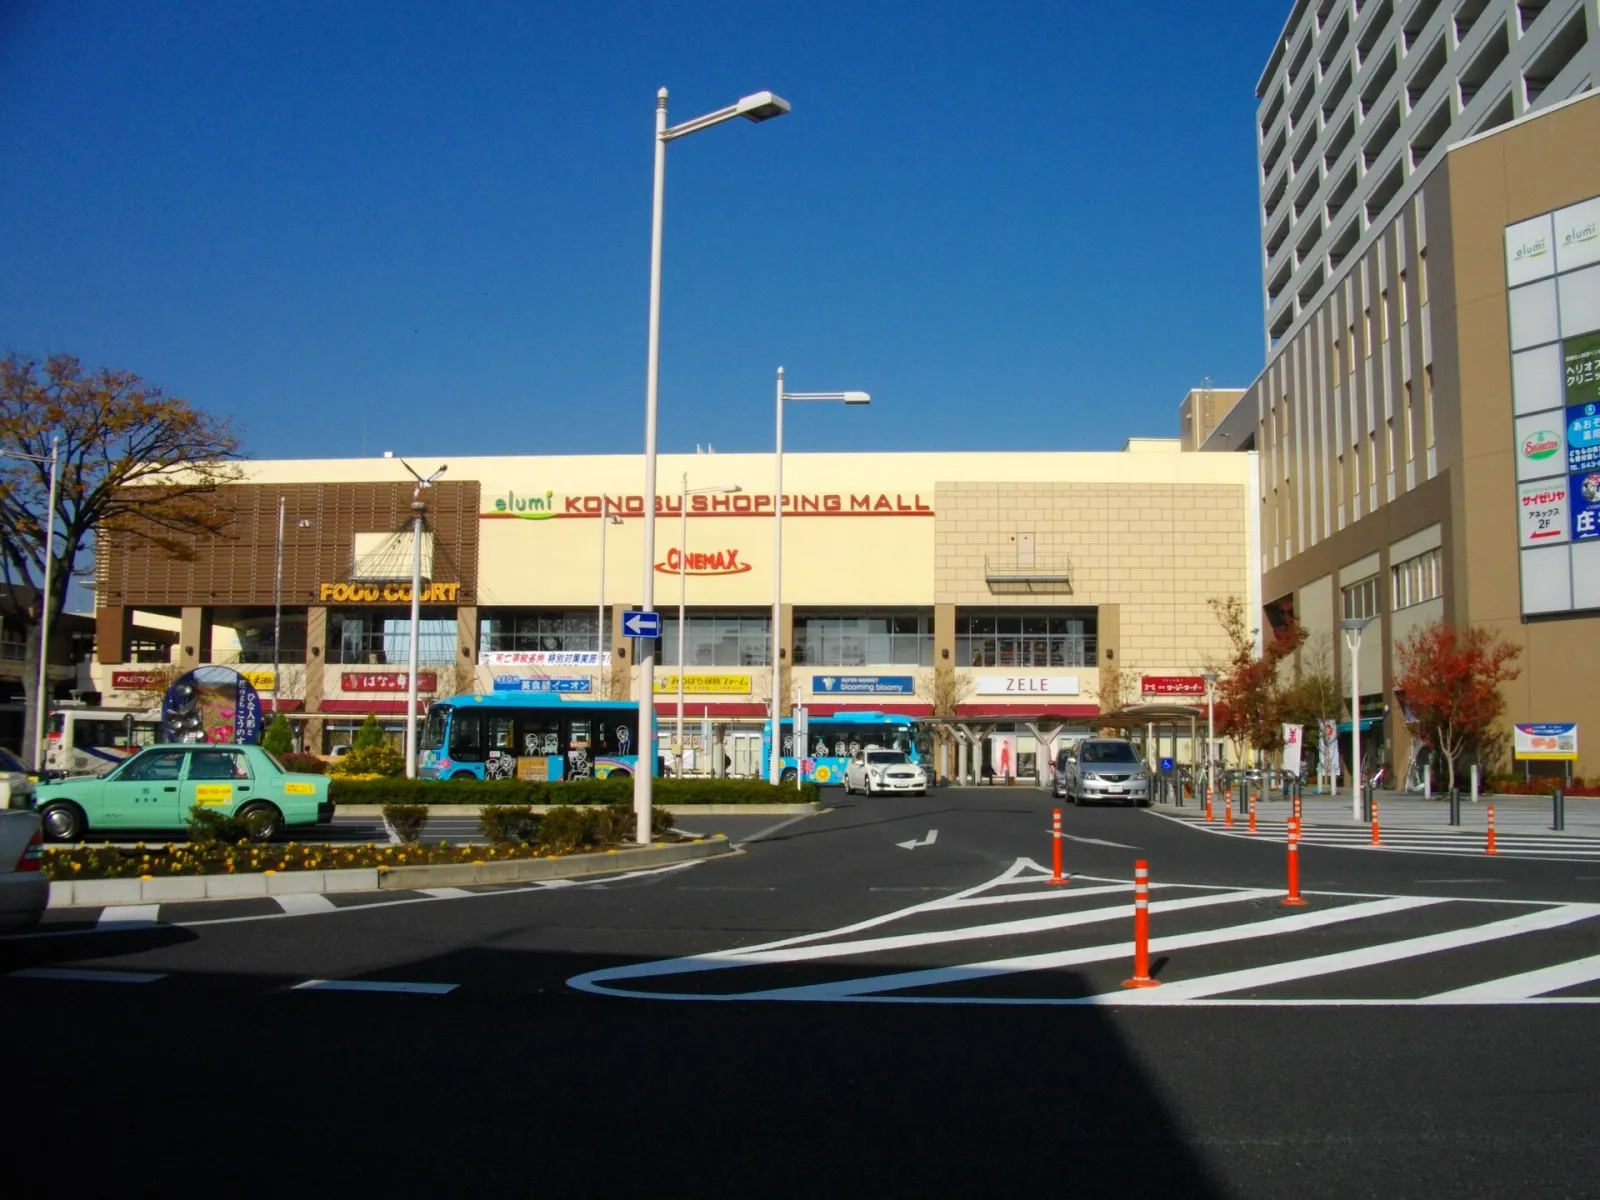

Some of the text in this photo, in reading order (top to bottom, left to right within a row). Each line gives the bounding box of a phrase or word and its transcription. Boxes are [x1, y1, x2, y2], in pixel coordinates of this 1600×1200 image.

[1565, 223, 1596, 242] elumi
[1516, 238, 1546, 257] elumi
[495, 490, 552, 511] elumi
[691, 494, 841, 511] SHOPPING
[850, 494, 930, 511] MALL
[1522, 490, 1565, 506] サイゼリヤ
[1528, 508, 1560, 519] アネックス
[1577, 510, 1600, 532] 庄
[1538, 518, 1551, 529] 2F
[667, 547, 739, 570] CINEMAX
[320, 583, 461, 602] FOOD COURT
[841, 683, 903, 692] blooming bloomy
[1006, 678, 1048, 691] ZELE
